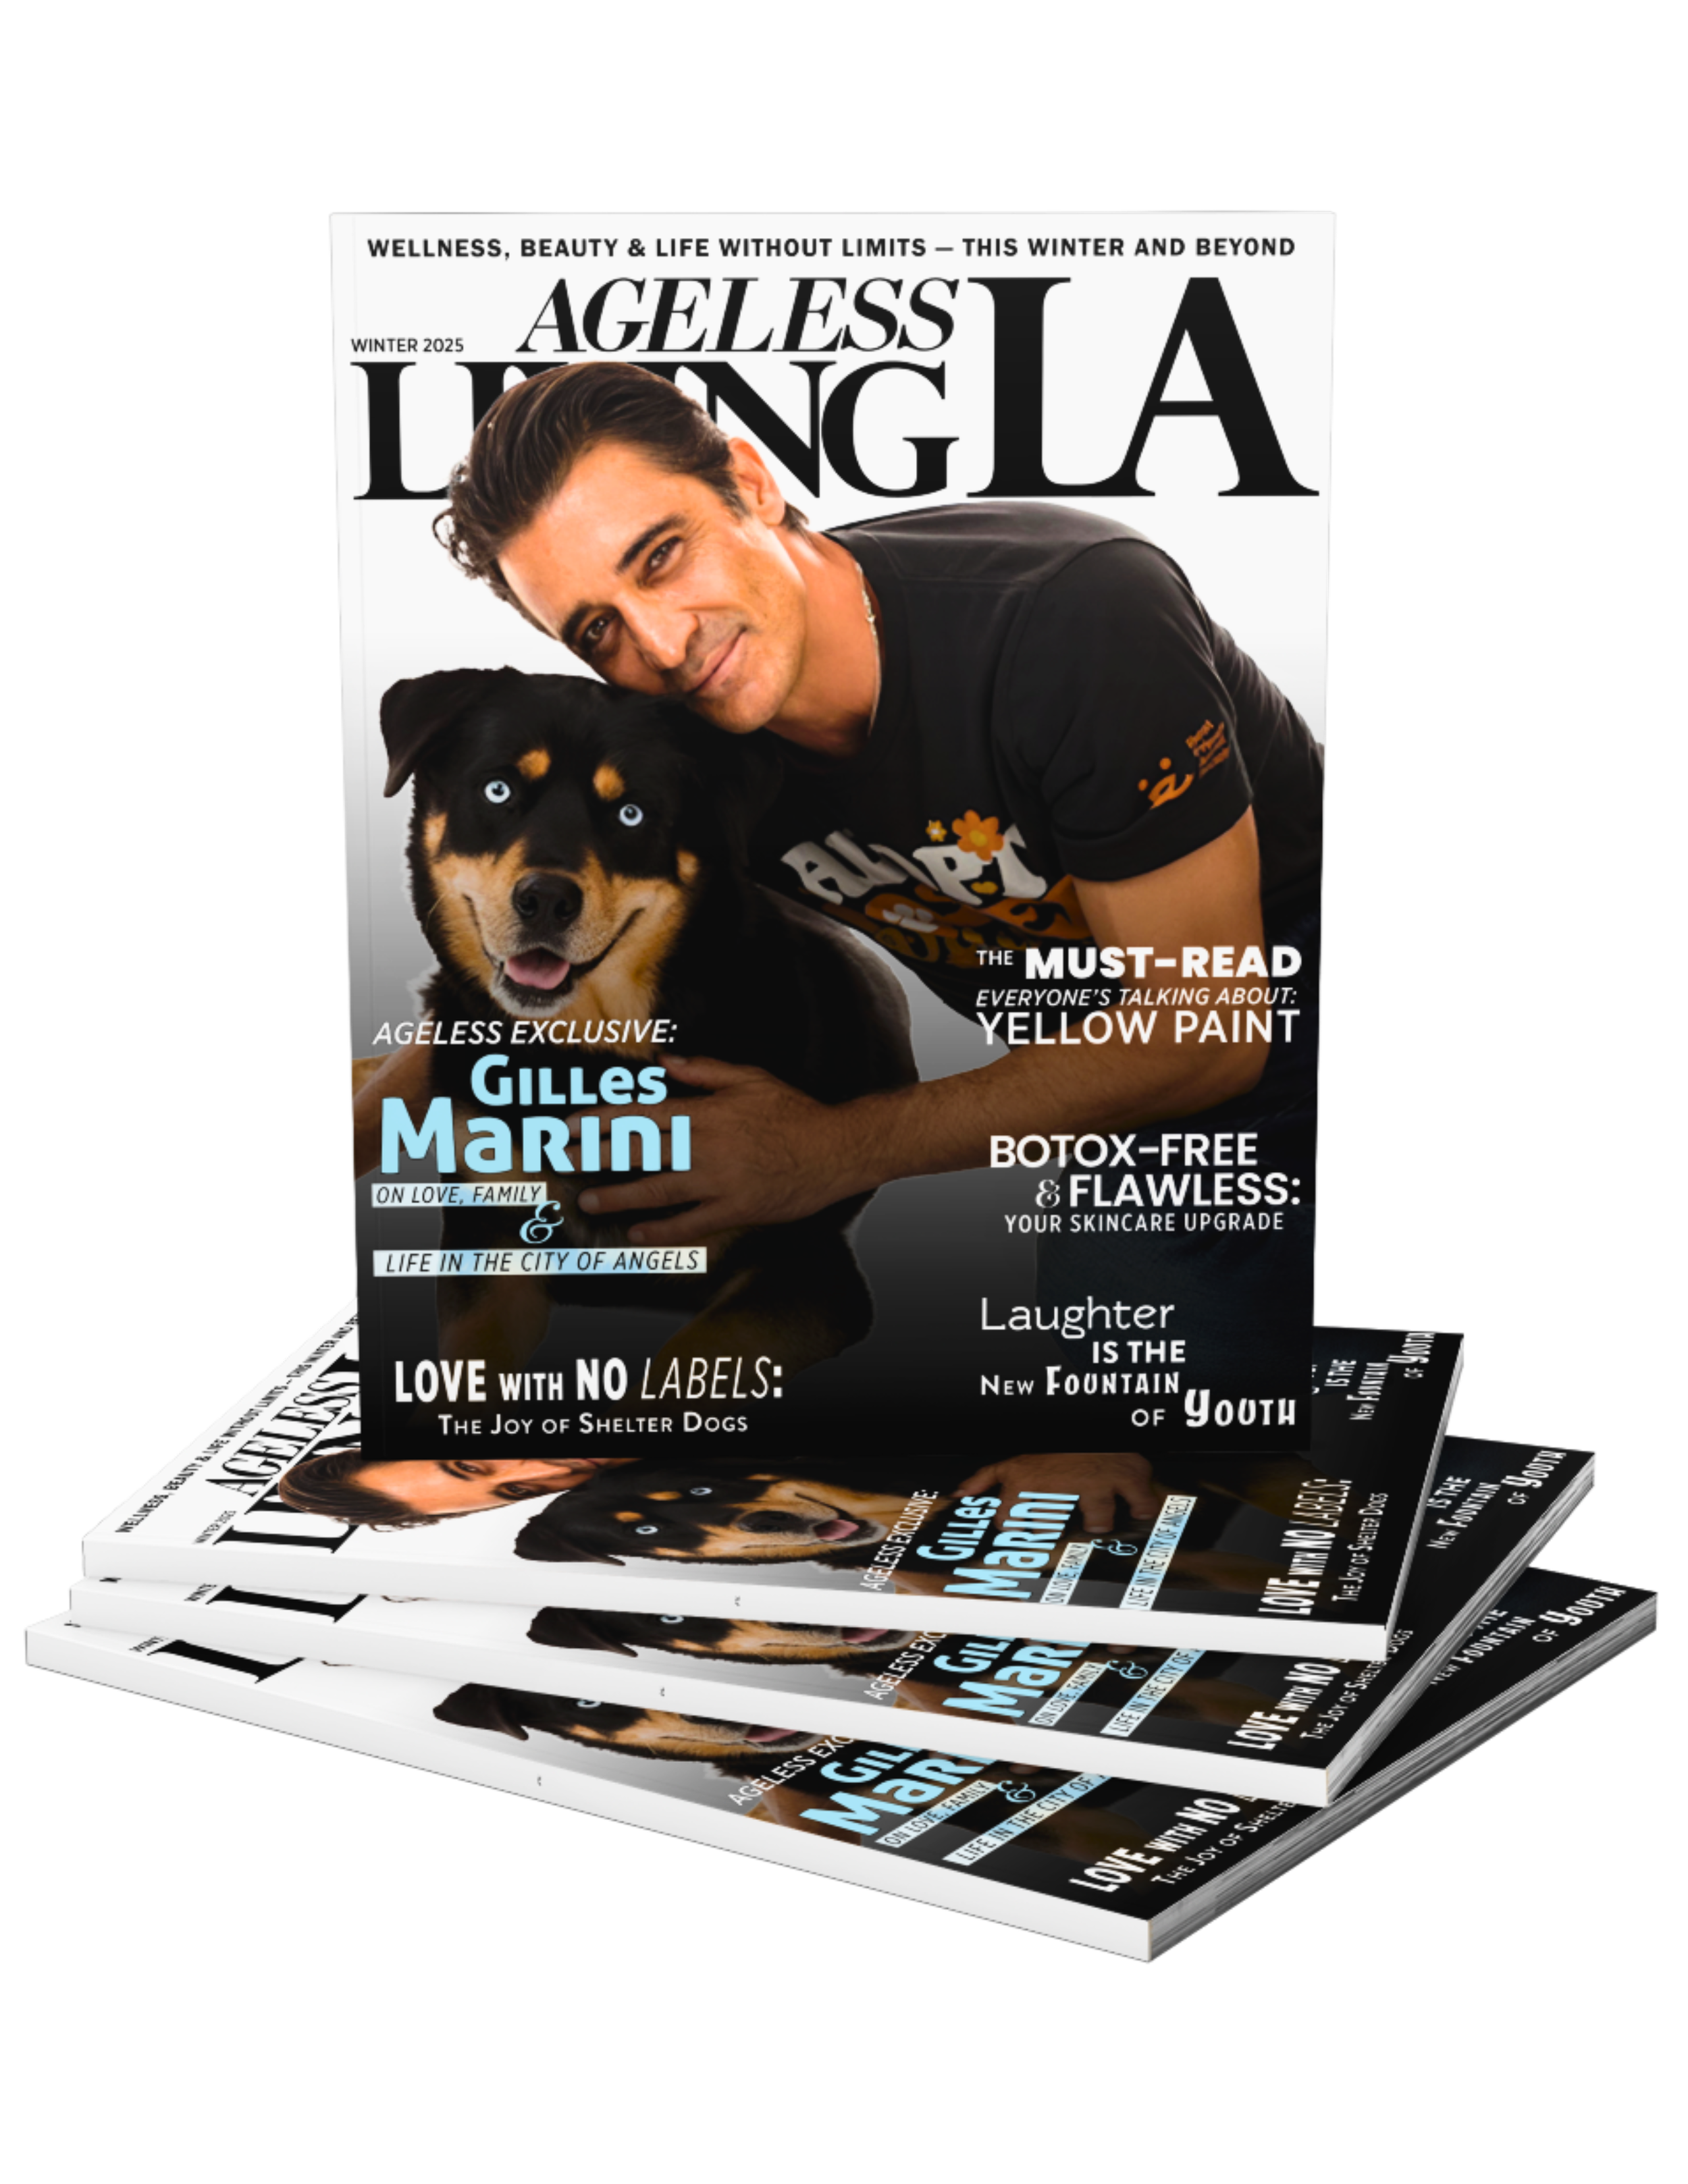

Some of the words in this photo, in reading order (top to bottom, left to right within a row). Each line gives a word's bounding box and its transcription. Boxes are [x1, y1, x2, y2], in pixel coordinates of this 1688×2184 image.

[367, 238, 510, 258] WELLNESS,
[521, 238, 617, 257] BEAUTY
[627, 238, 645, 257] &
[656, 238, 709, 257] LIFE
[718, 238, 833, 257] WITHOUT
[843, 238, 926, 257] LIMITS
[962, 238, 1018, 257] THIS
[1028, 238, 1124, 257] WINTER
[1134, 238, 1185, 256] AND
[1196, 238, 1295, 256] BEYOND
[515, 277, 959, 352] AGELESS
[351, 338, 418, 352] WINTER
[423, 338, 464, 352] 2025
[966, 277, 1320, 498] LA
[350, 361, 959, 498] LNG
[976, 950, 1013, 965] THE
[1119, 988, 1210, 1005] TALKING
[1215, 987, 1296, 1005] ABOUT:
[371, 1020, 502, 1045] AGELESS
[510, 1019, 677, 1044] EXCLUSIVE:
[976, 1011, 1157, 1045] YELLOW
[1176, 1010, 1300, 1043] PAINT
[376, 1187, 404, 1203] ON
[411, 1186, 464, 1204] LOVE,
[473, 1186, 542, 1202] FAMILY
[1036, 1179, 1060, 1207] &
[1070, 1172, 1300, 1207] FLAWLESS:
[519, 1201, 564, 1244] &
[1005, 1215, 1061, 1233] YOUR
[1071, 1213, 1175, 1232] SKINCARE
[1184, 1213, 1283, 1231] UPGRADE
[386, 1253, 431, 1272] LIFE
[440, 1253, 463, 1271] IN
[473, 1252, 513, 1271] THE
[521, 1252, 570, 1271] CITY
[577, 1252, 606, 1270] OF
[613, 1251, 700, 1271] ANGELS
[981, 1296, 1175, 1339] Laughter
[1093, 1341, 1118, 1364] IS
[1127, 1340, 1186, 1363] THE
[1327, 1359, 1356, 1376] THE
[395, 1360, 487, 1402] LOVE
[498, 1373, 564, 1400] WITH
[576, 1358, 627, 1400] NO
[641, 1356, 783, 1400] LABELS:
[1324, 1378, 1350, 1387] IS
[542, 1418, 570, 1433] OF
[1132, 1409, 1164, 1427] OF
[205, 1379, 359, 1497] AGELESS
[115, 1493, 175, 1533] WELLNESS,
[163, 1463, 203, 1490] BEAUTY
[202, 1439, 230, 1454] LIFE
[1433, 1475, 1471, 1497] THE
[1289, 1479, 1352, 1527] LABELS:
[1426, 1497, 1452, 1509] IS
[860, 1544, 906, 1591] AGELESS
[886, 1489, 939, 1545] EXCLUSIVE:
[1280, 1529, 1336, 1550] NO
[1287, 1551, 1329, 1576] WITH
[1257, 1577, 1321, 1616] LOVE
[864, 1652, 925, 1700] AGELESS
[1284, 1662, 1341, 1686] NO
[1344, 1657, 1392, 1690] SHELTE
[1109, 1711, 1141, 1732] LIFE
[1137, 1684, 1167, 1704] THE
[1274, 1685, 1323, 1712] WITH
[1034, 1714, 1055, 1726] ON
[1227, 1711, 1300, 1751] LOVE
[728, 1755, 817, 1806] AGELESS
[885, 1830, 912, 1846] ON
[941, 1782, 987, 1811] FAMILY
[956, 1838, 997, 1861] LIFE
[988, 1826, 1013, 1841] IN
[1006, 1809, 1039, 1829] THE
[1037, 1788, 1075, 1811] CITY
[1070, 1776, 1094, 1792] OF
[1069, 1848, 1163, 1892] LOVE
[1144, 1823, 1207, 1853] WITH
[1176, 1798, 1240, 1826] NO
